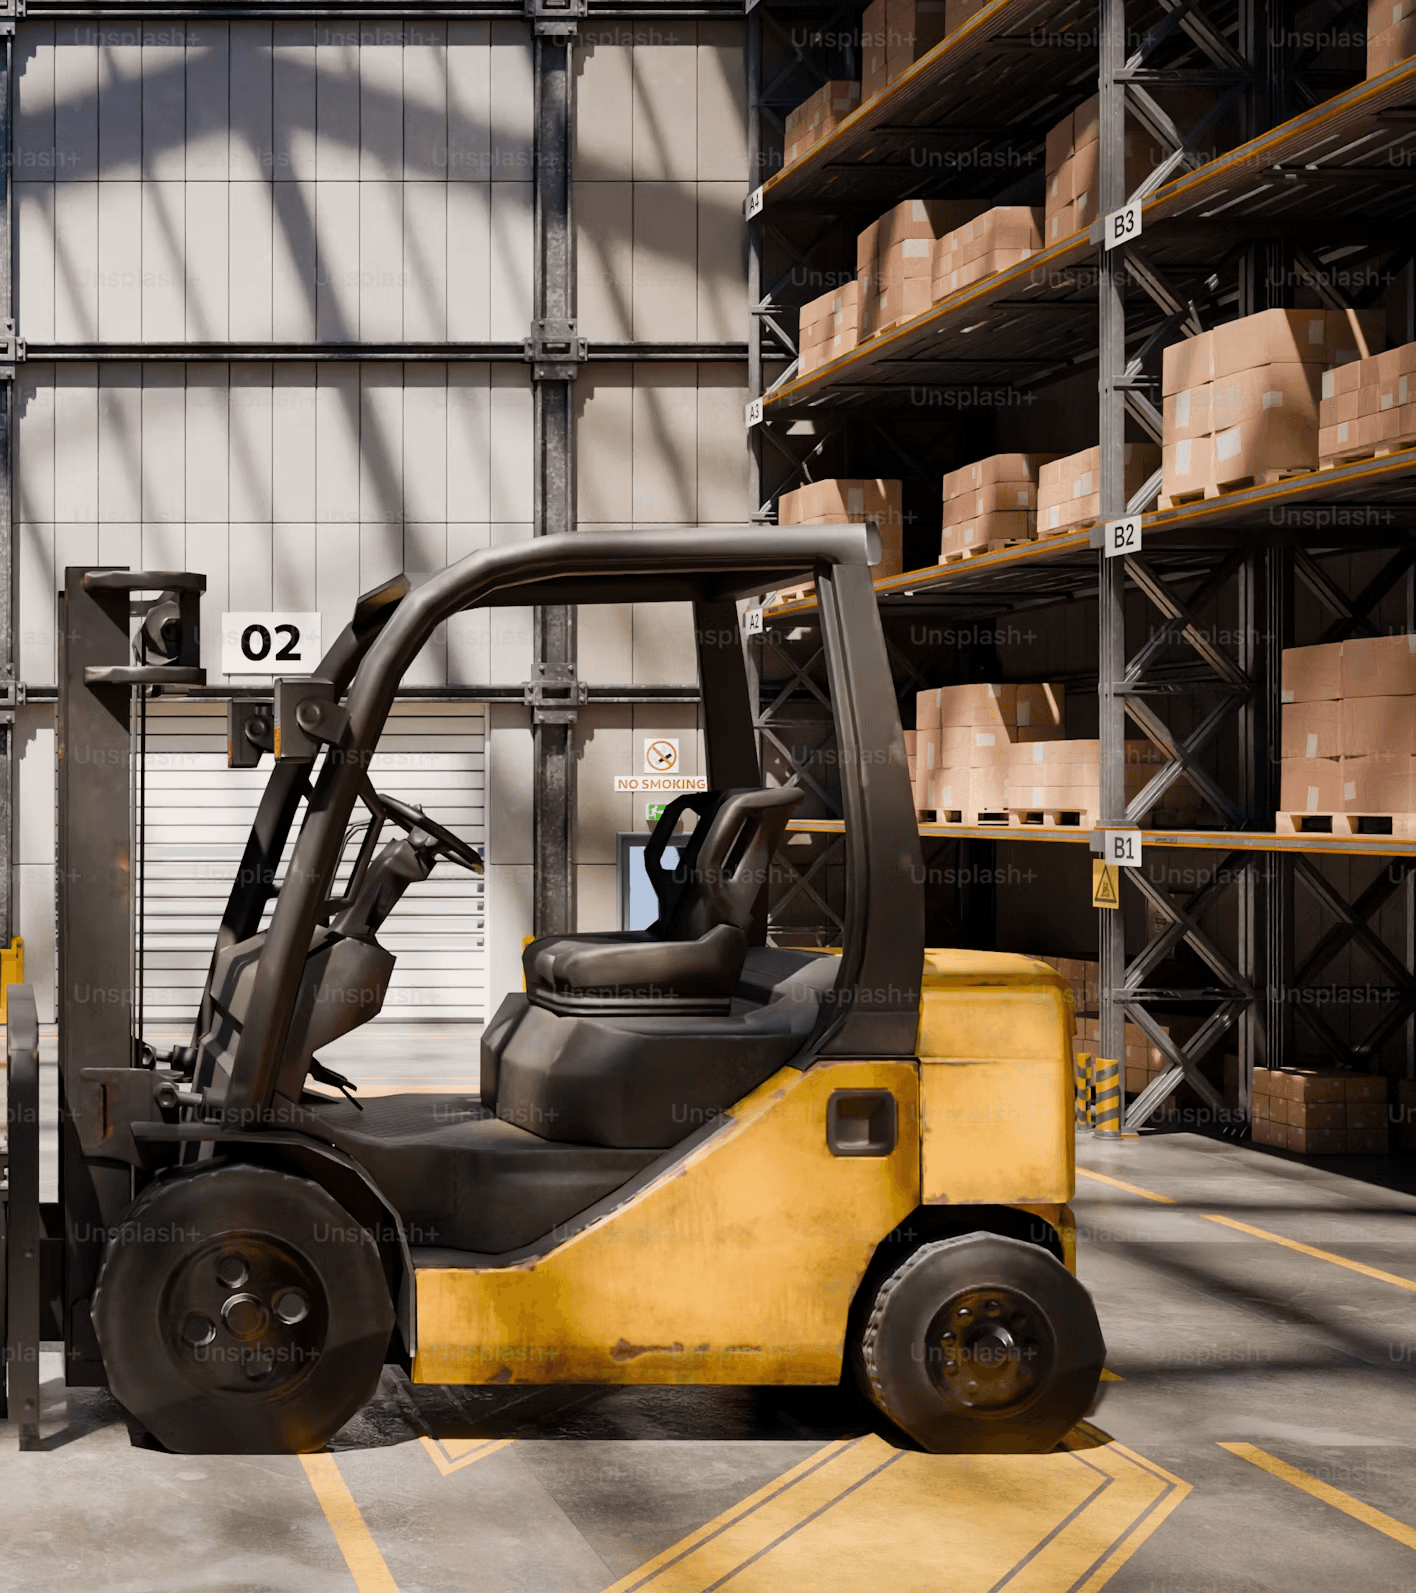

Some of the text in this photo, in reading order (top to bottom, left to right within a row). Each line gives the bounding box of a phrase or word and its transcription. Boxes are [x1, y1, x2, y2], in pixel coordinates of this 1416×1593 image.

[749, 193, 760, 213] A4
[1115, 210, 1134, 239] B3
[749, 403, 760, 421] A3
[1115, 524, 1134, 549] B2
[749, 614, 760, 630] A2
[241, 624, 301, 661] 02
[618, 779, 706, 790] NO SMOKING
[1114, 837, 1134, 859] B1
